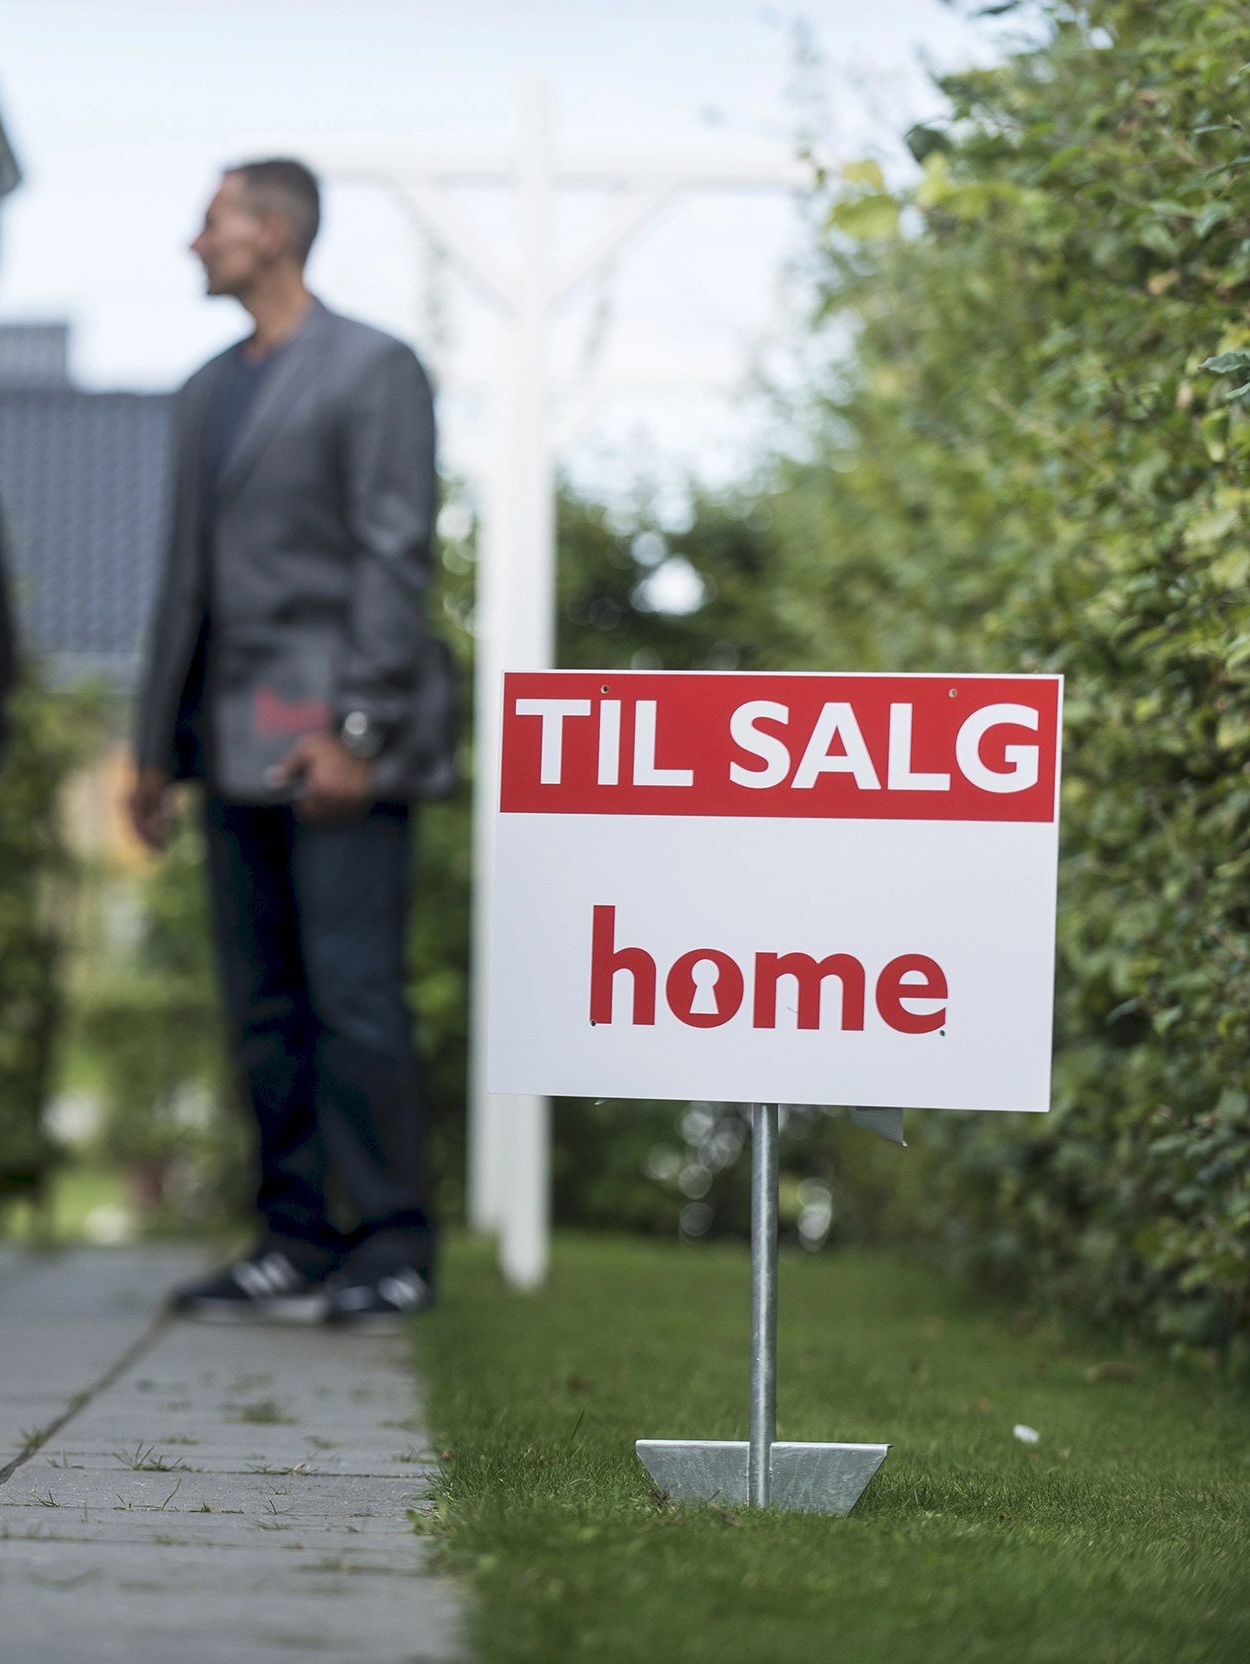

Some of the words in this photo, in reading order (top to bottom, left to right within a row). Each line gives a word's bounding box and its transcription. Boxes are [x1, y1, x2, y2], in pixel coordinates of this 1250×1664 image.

[515, 698, 694, 787] TIL
[729, 700, 1040, 794] SALG
[589, 904, 949, 1035] home
